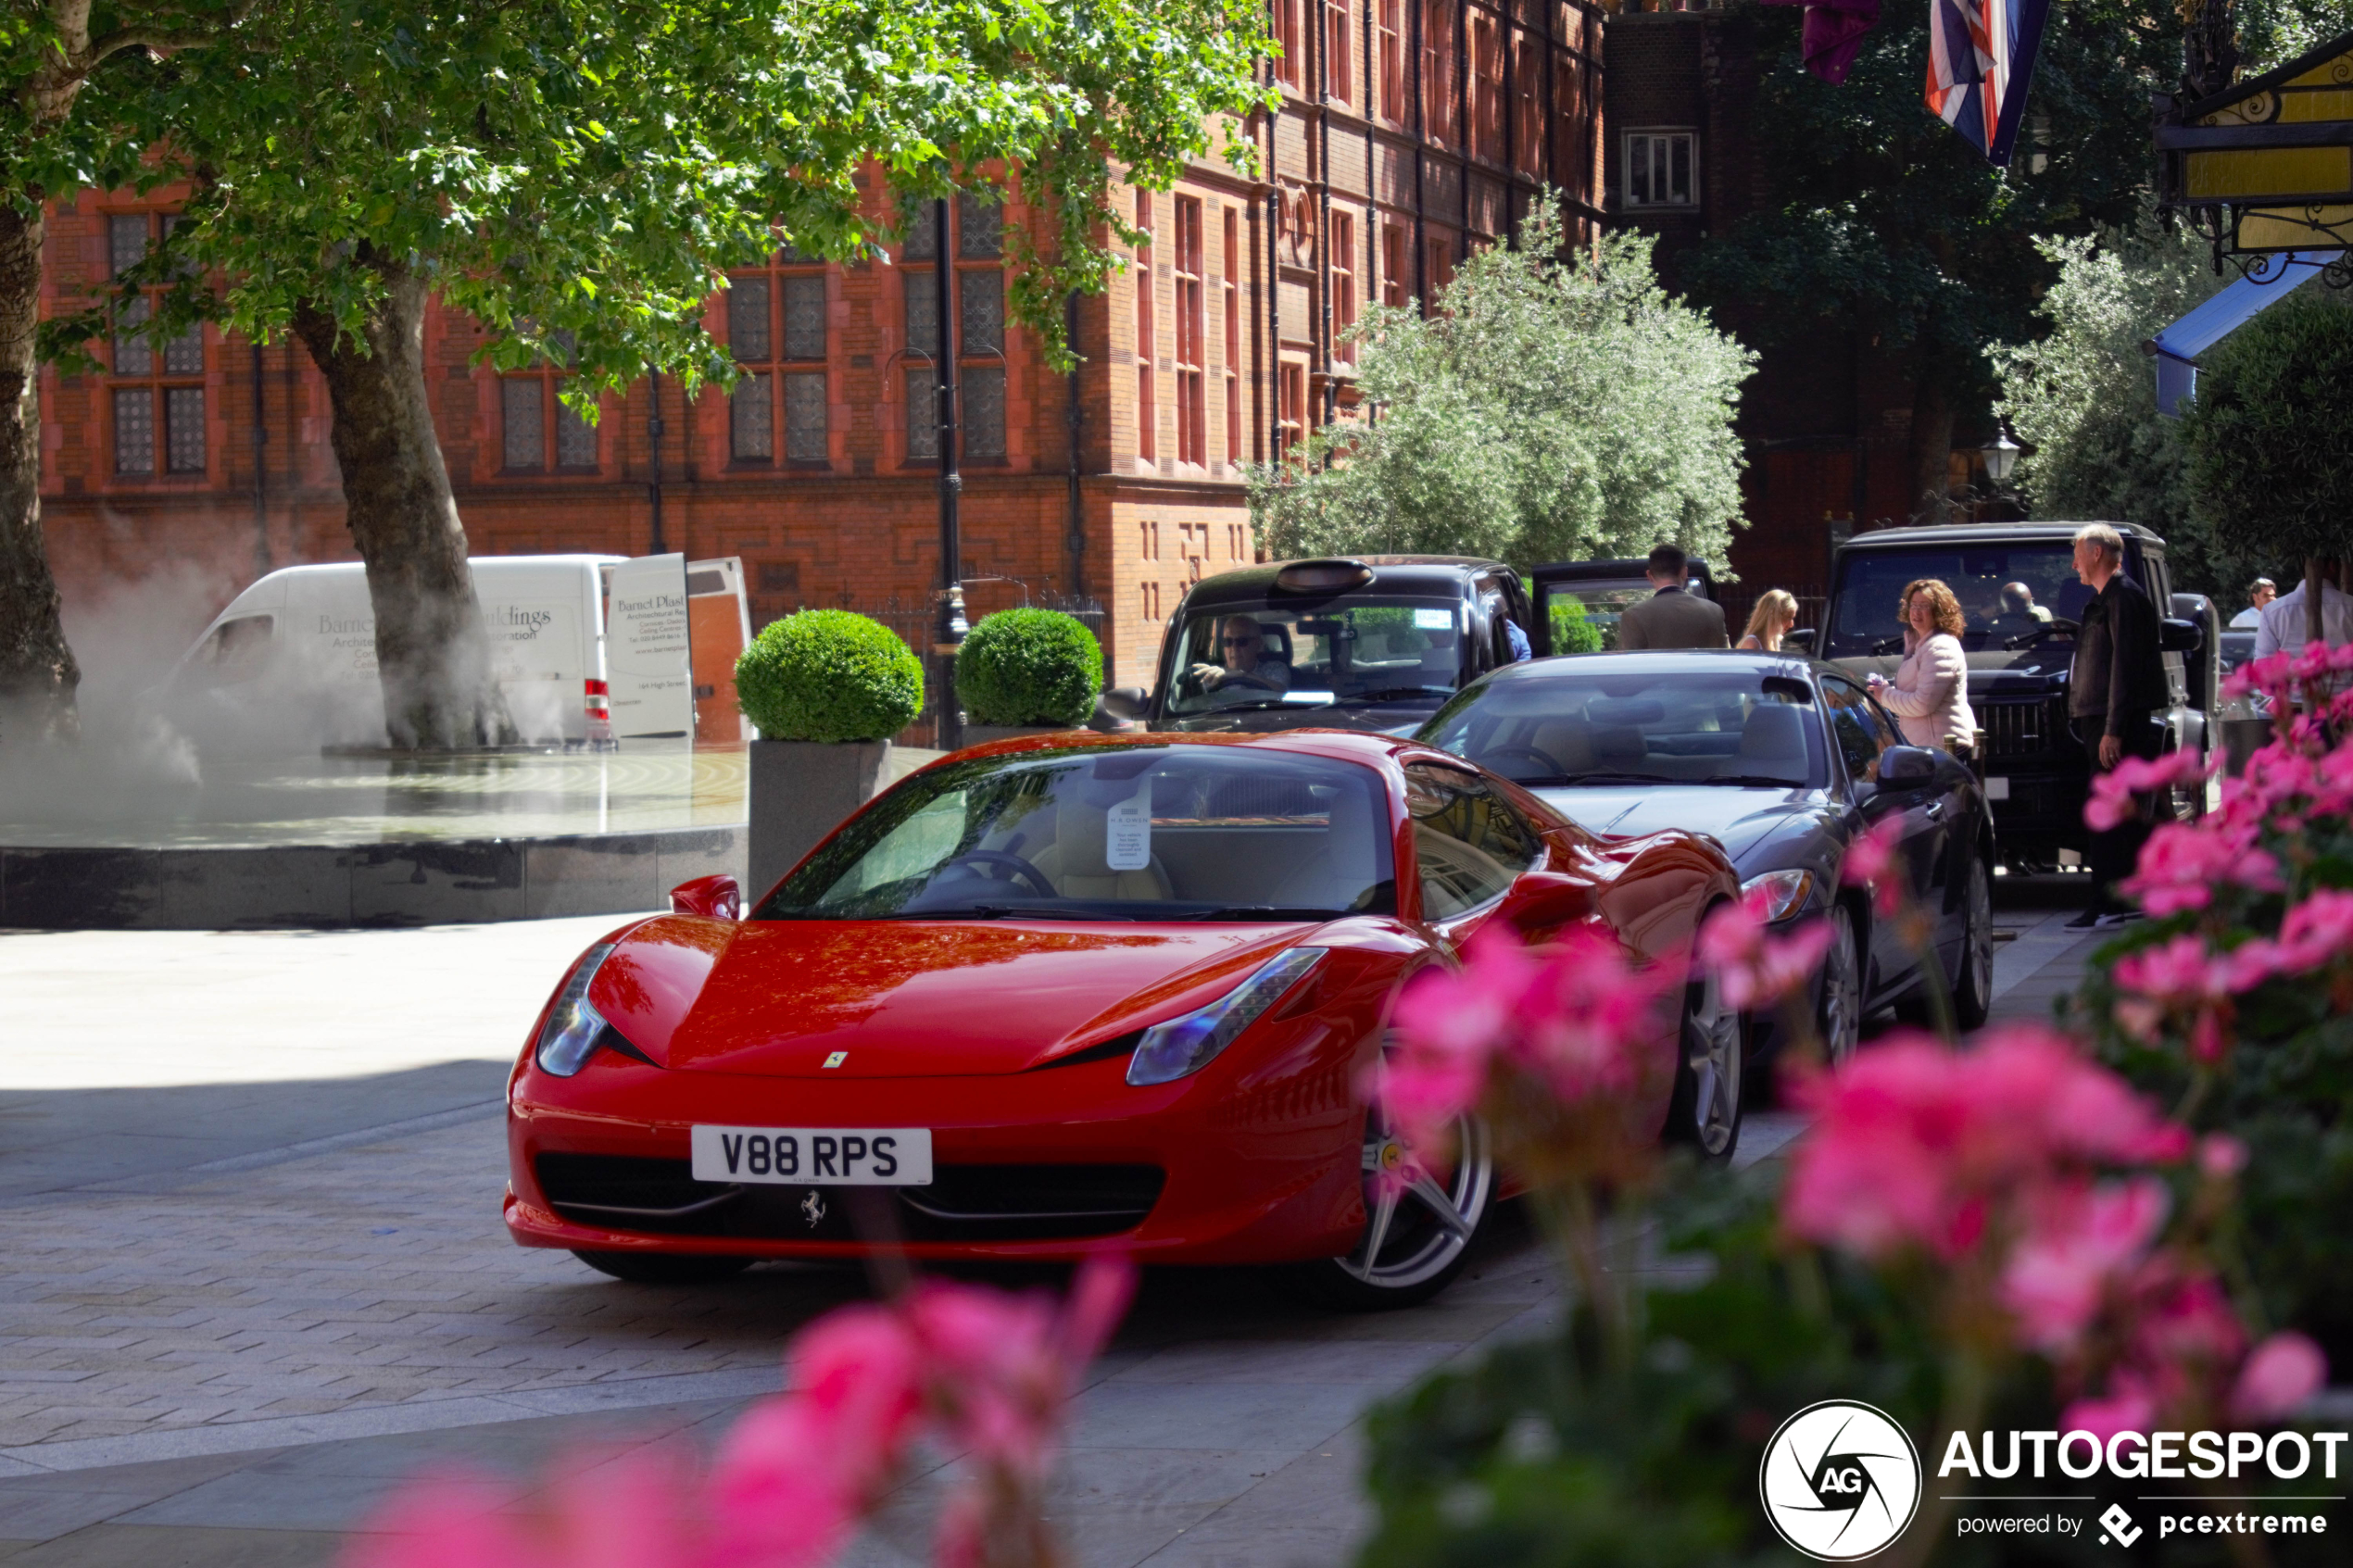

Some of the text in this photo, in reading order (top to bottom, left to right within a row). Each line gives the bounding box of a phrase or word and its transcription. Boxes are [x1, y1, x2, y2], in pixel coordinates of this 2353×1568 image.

[618, 596, 685, 612] Barnet Plast
[318, 606, 551, 634] Barne uldings
[333, 636, 376, 648] Archite
[490, 630, 536, 641] toration
[650, 682, 665, 690] High
[721, 1134, 898, 1177] V88 RPS
